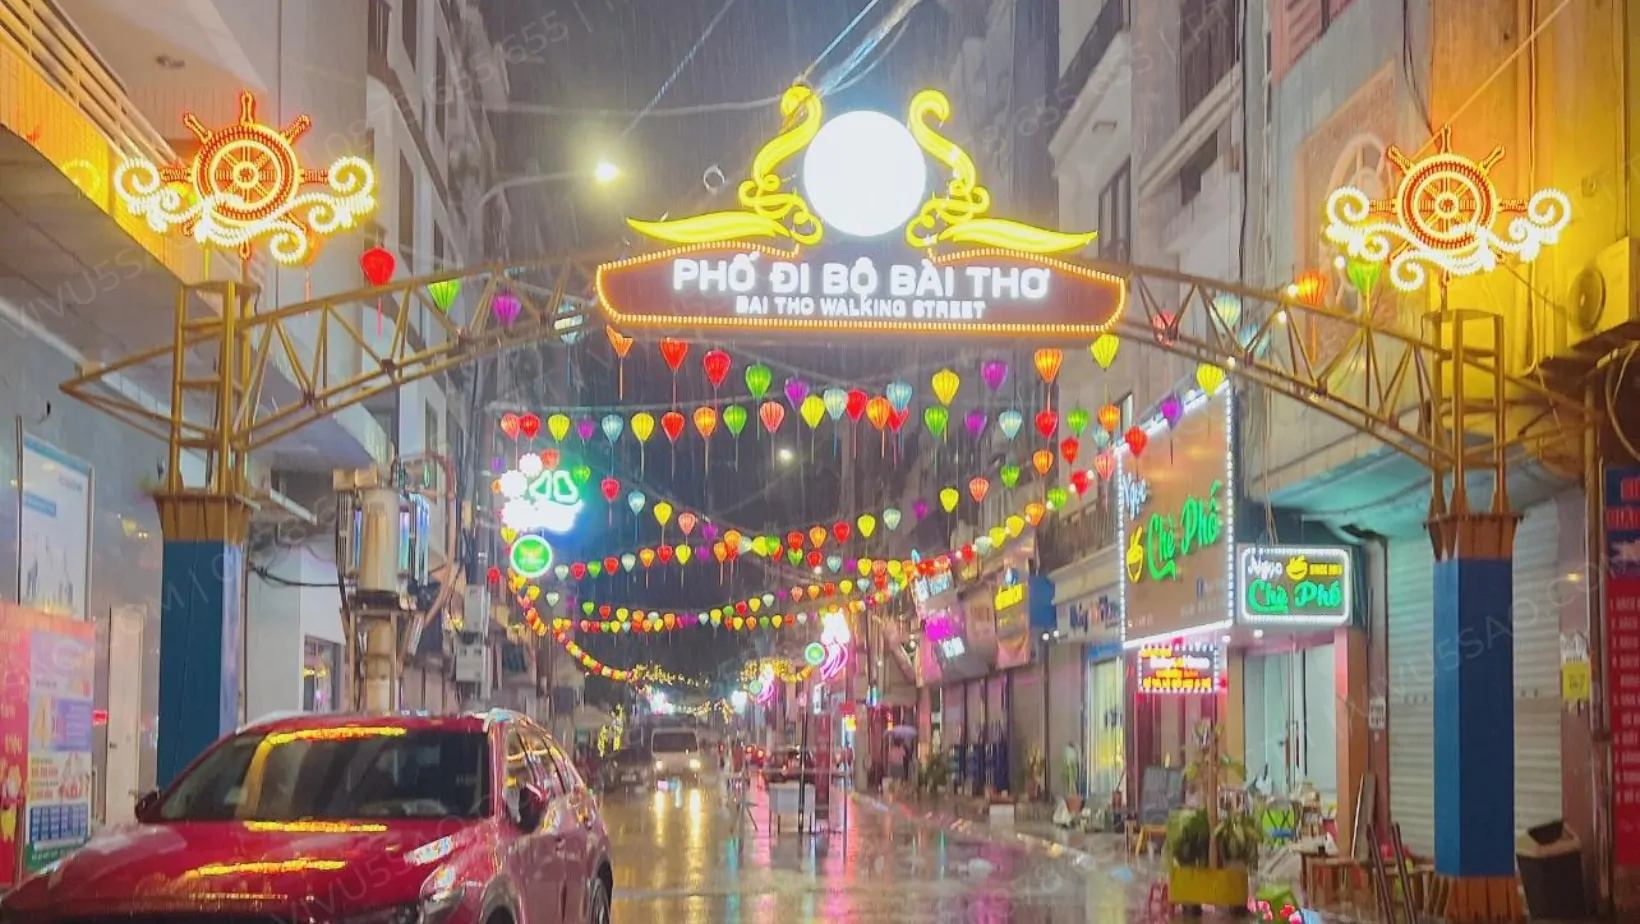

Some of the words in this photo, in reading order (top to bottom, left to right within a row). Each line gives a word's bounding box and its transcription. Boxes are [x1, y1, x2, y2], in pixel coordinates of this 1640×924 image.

[672, 250, 760, 291] PHỐ
[769, 262, 810, 294] ĐI
[822, 256, 878, 301] BỘ
[890, 258, 954, 297] BÀI
[966, 266, 1051, 299] THƠ
[736, 295, 769, 314] BAI
[774, 295, 815, 315] THO
[819, 296, 906, 318] WALKING
[912, 299, 986, 320] STREET
[1147, 512, 1177, 581] Chè
[1181, 479, 1224, 556] Phố
[1248, 578, 1289, 614] Chè
[1294, 578, 1342, 608] Phố
